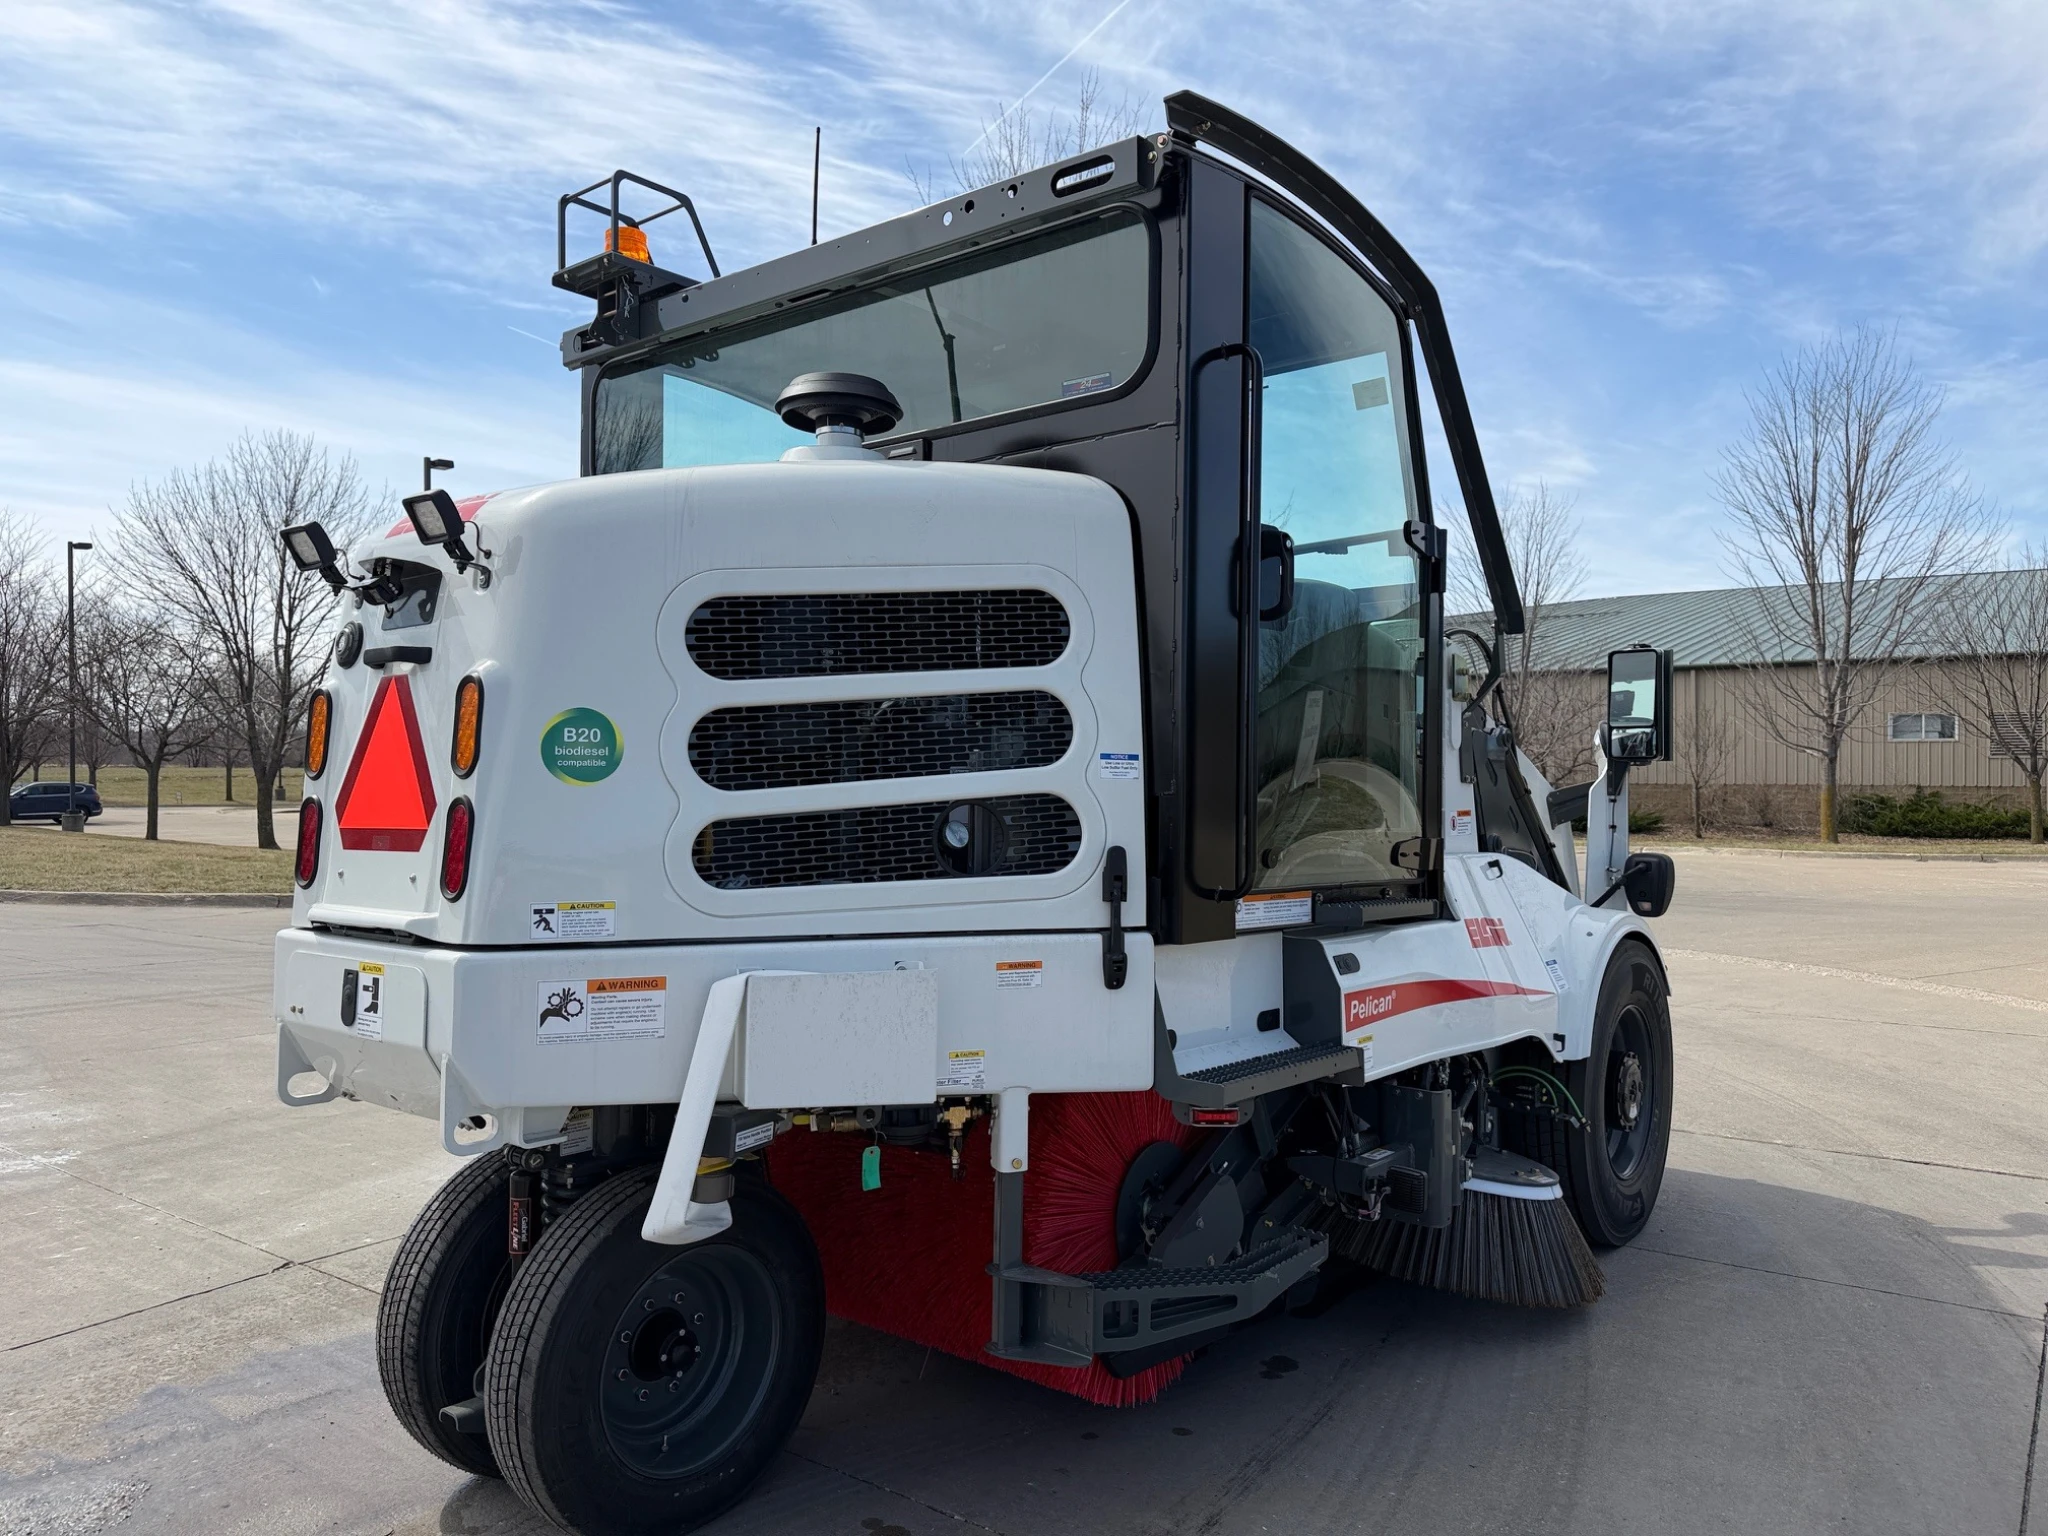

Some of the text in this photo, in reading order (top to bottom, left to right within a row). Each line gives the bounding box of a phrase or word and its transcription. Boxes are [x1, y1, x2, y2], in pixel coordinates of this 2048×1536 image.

[563, 727, 601, 743] B20
[554, 745, 609, 756] biodiesel
[557, 759, 607, 767] compatible
[608, 980, 659, 990] WARNING
